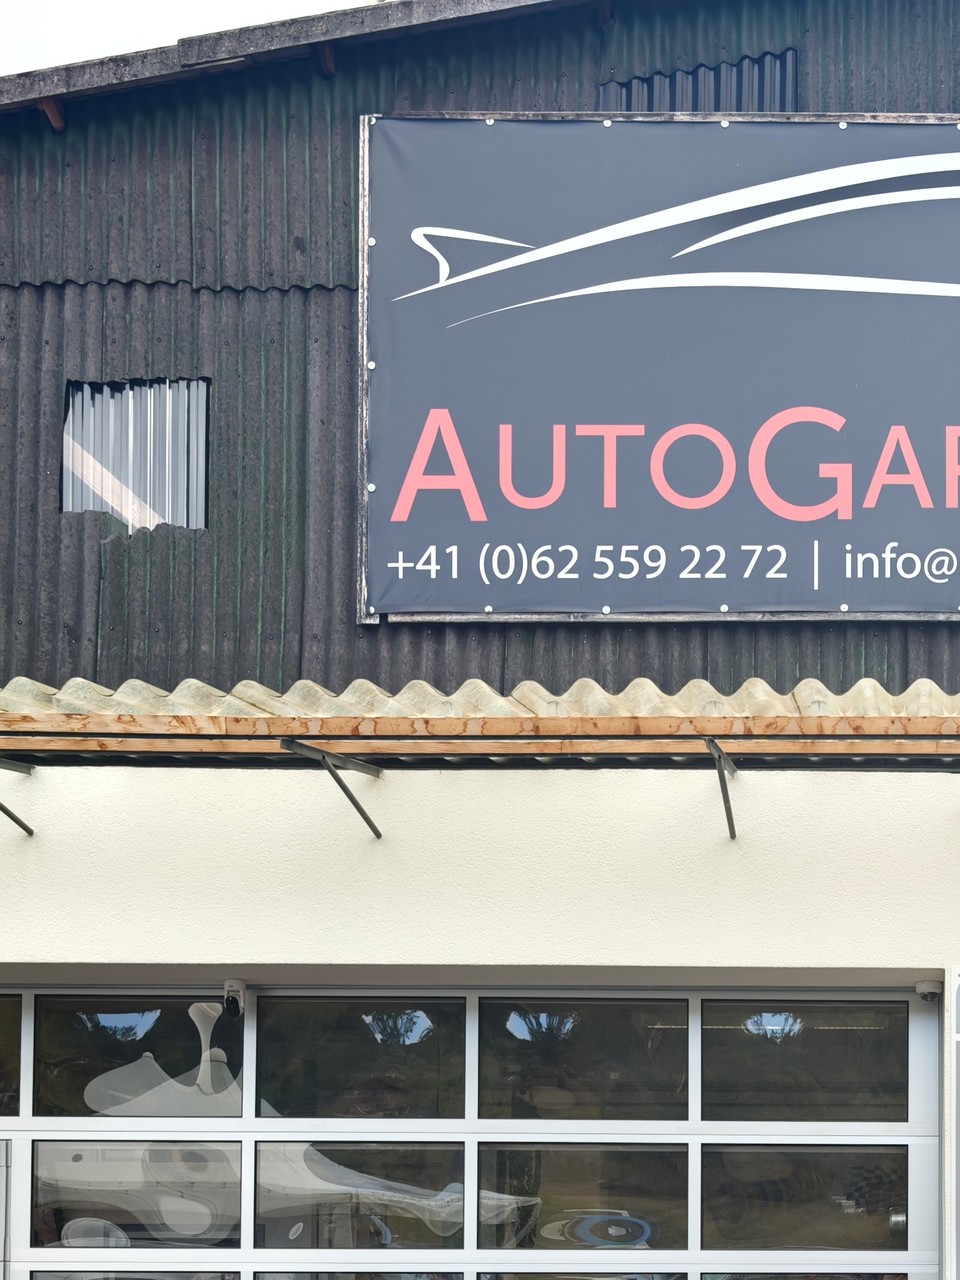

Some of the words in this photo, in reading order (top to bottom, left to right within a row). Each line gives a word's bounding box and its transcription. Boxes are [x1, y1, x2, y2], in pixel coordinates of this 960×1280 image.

[387, 545, 458, 579] +41
[479, 542, 579, 585] (0)62
[592, 544, 667, 580] 559
[679, 544, 727, 579] 22
[740, 544, 788, 579] 72
